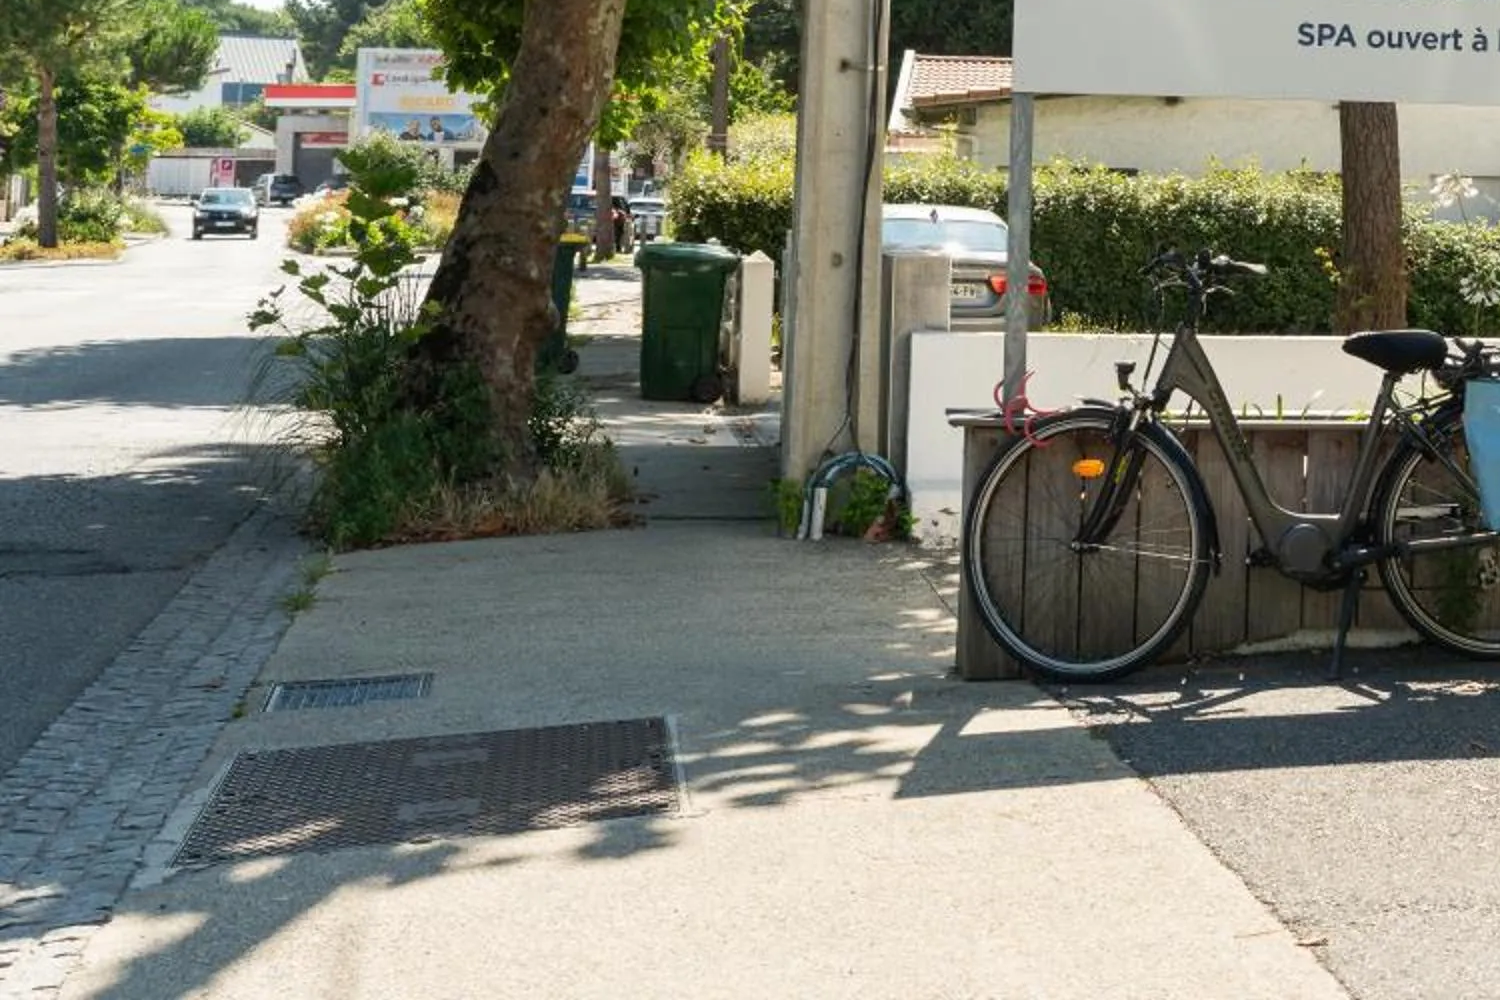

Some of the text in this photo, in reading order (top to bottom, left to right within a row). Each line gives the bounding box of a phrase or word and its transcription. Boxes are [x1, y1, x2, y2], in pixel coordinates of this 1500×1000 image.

[1297, 22, 1357, 49] SPA
[1366, 28, 1463, 52] ouvert
[1471, 26, 1489, 53] à
